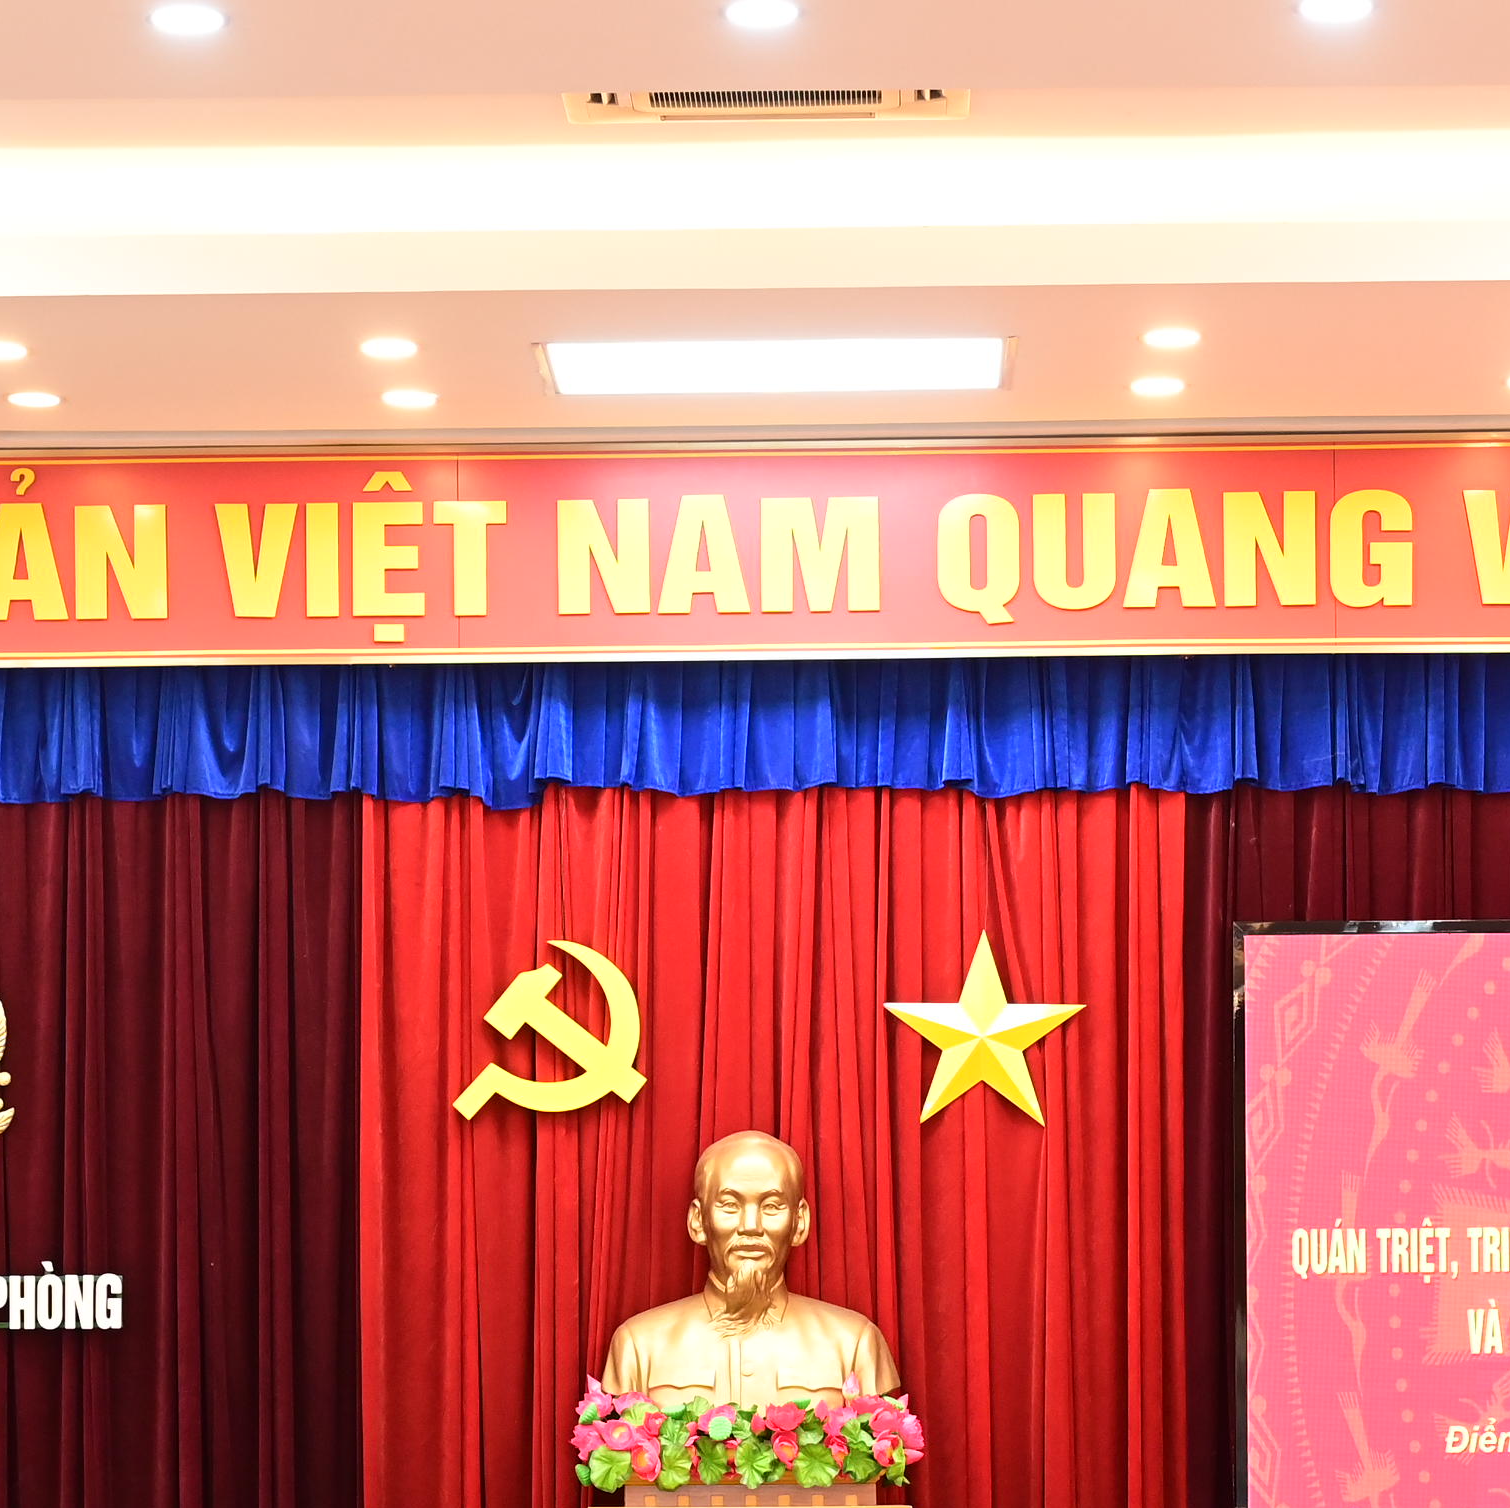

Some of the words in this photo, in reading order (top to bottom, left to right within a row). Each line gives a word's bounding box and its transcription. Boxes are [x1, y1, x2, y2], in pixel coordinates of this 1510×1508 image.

[215, 472, 506, 641] VIỆT
[558, 494, 880, 614] NAM
[937, 489, 1412, 624] QUANG
[1292, 1219, 1366, 1279] QUÁN
[1376, 1217, 1458, 1283] TRIỆT,
[1467, 1299, 1503, 1354] VÀ
